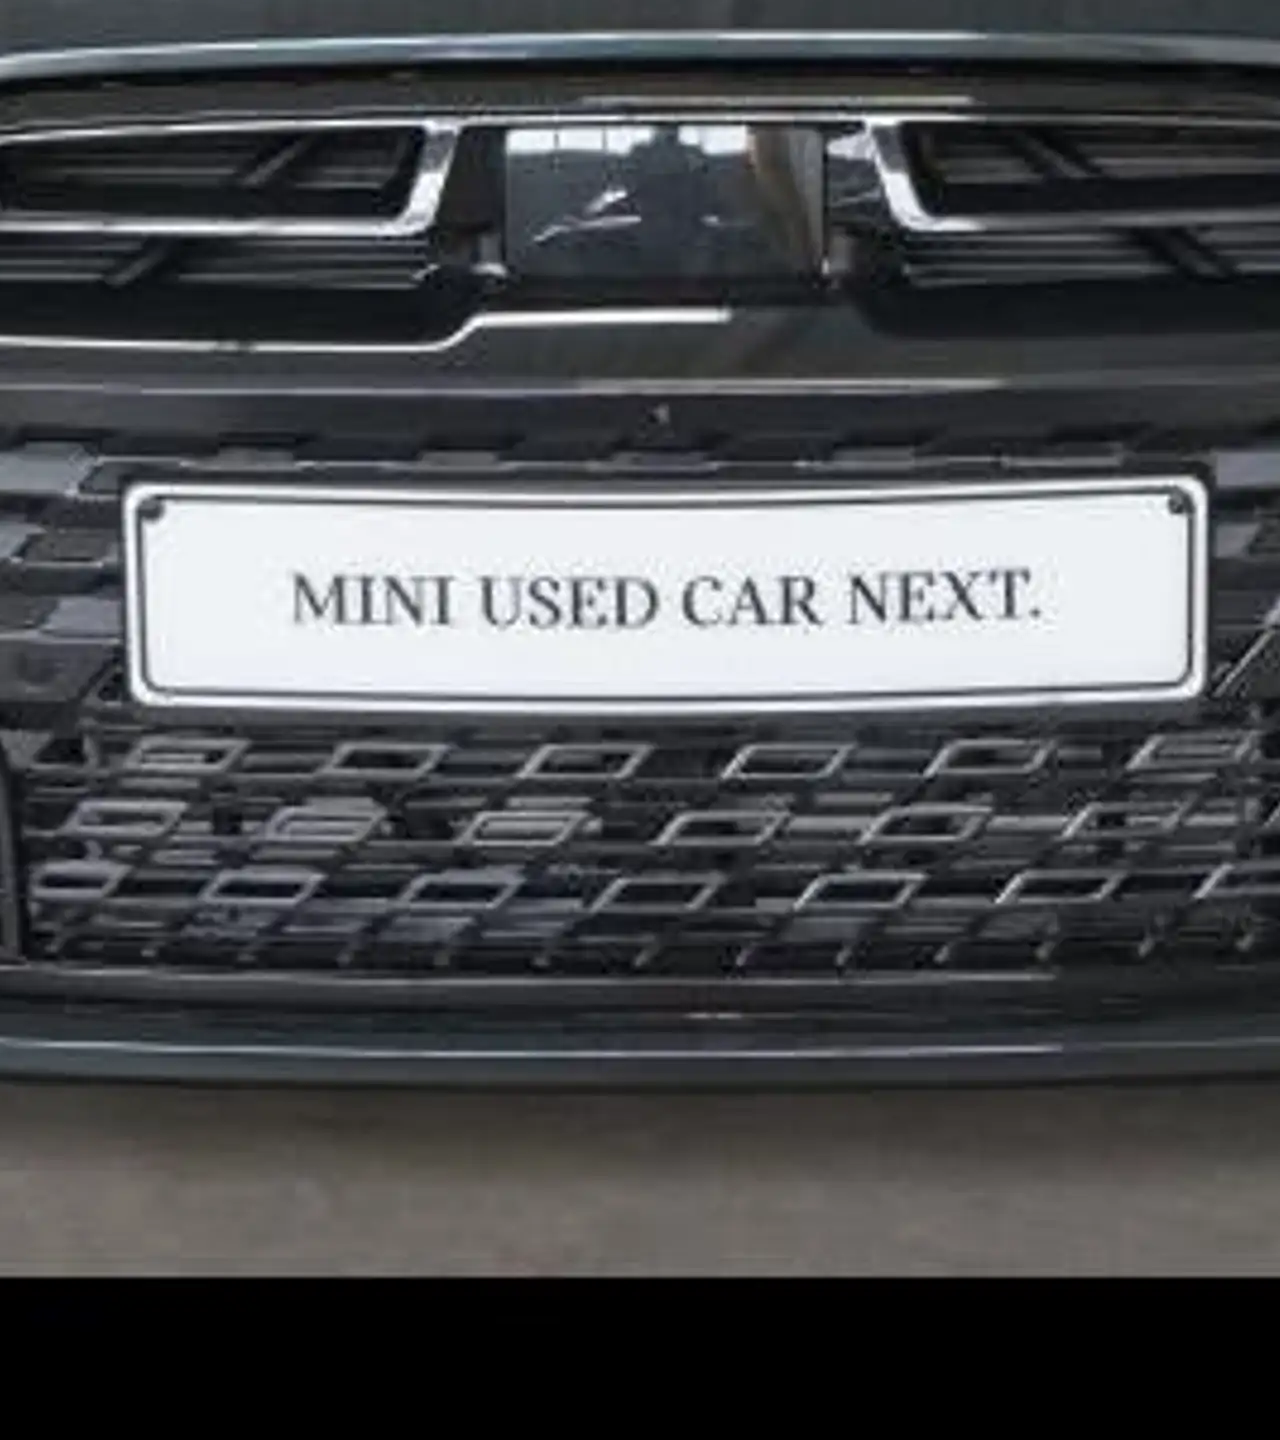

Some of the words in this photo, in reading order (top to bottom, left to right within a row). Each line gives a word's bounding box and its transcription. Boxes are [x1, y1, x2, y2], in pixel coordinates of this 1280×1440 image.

[290, 573, 456, 626] MINI
[480, 575, 660, 627] USED
[680, 575, 822, 626] CAR
[848, 568, 1041, 624] NEXT.
